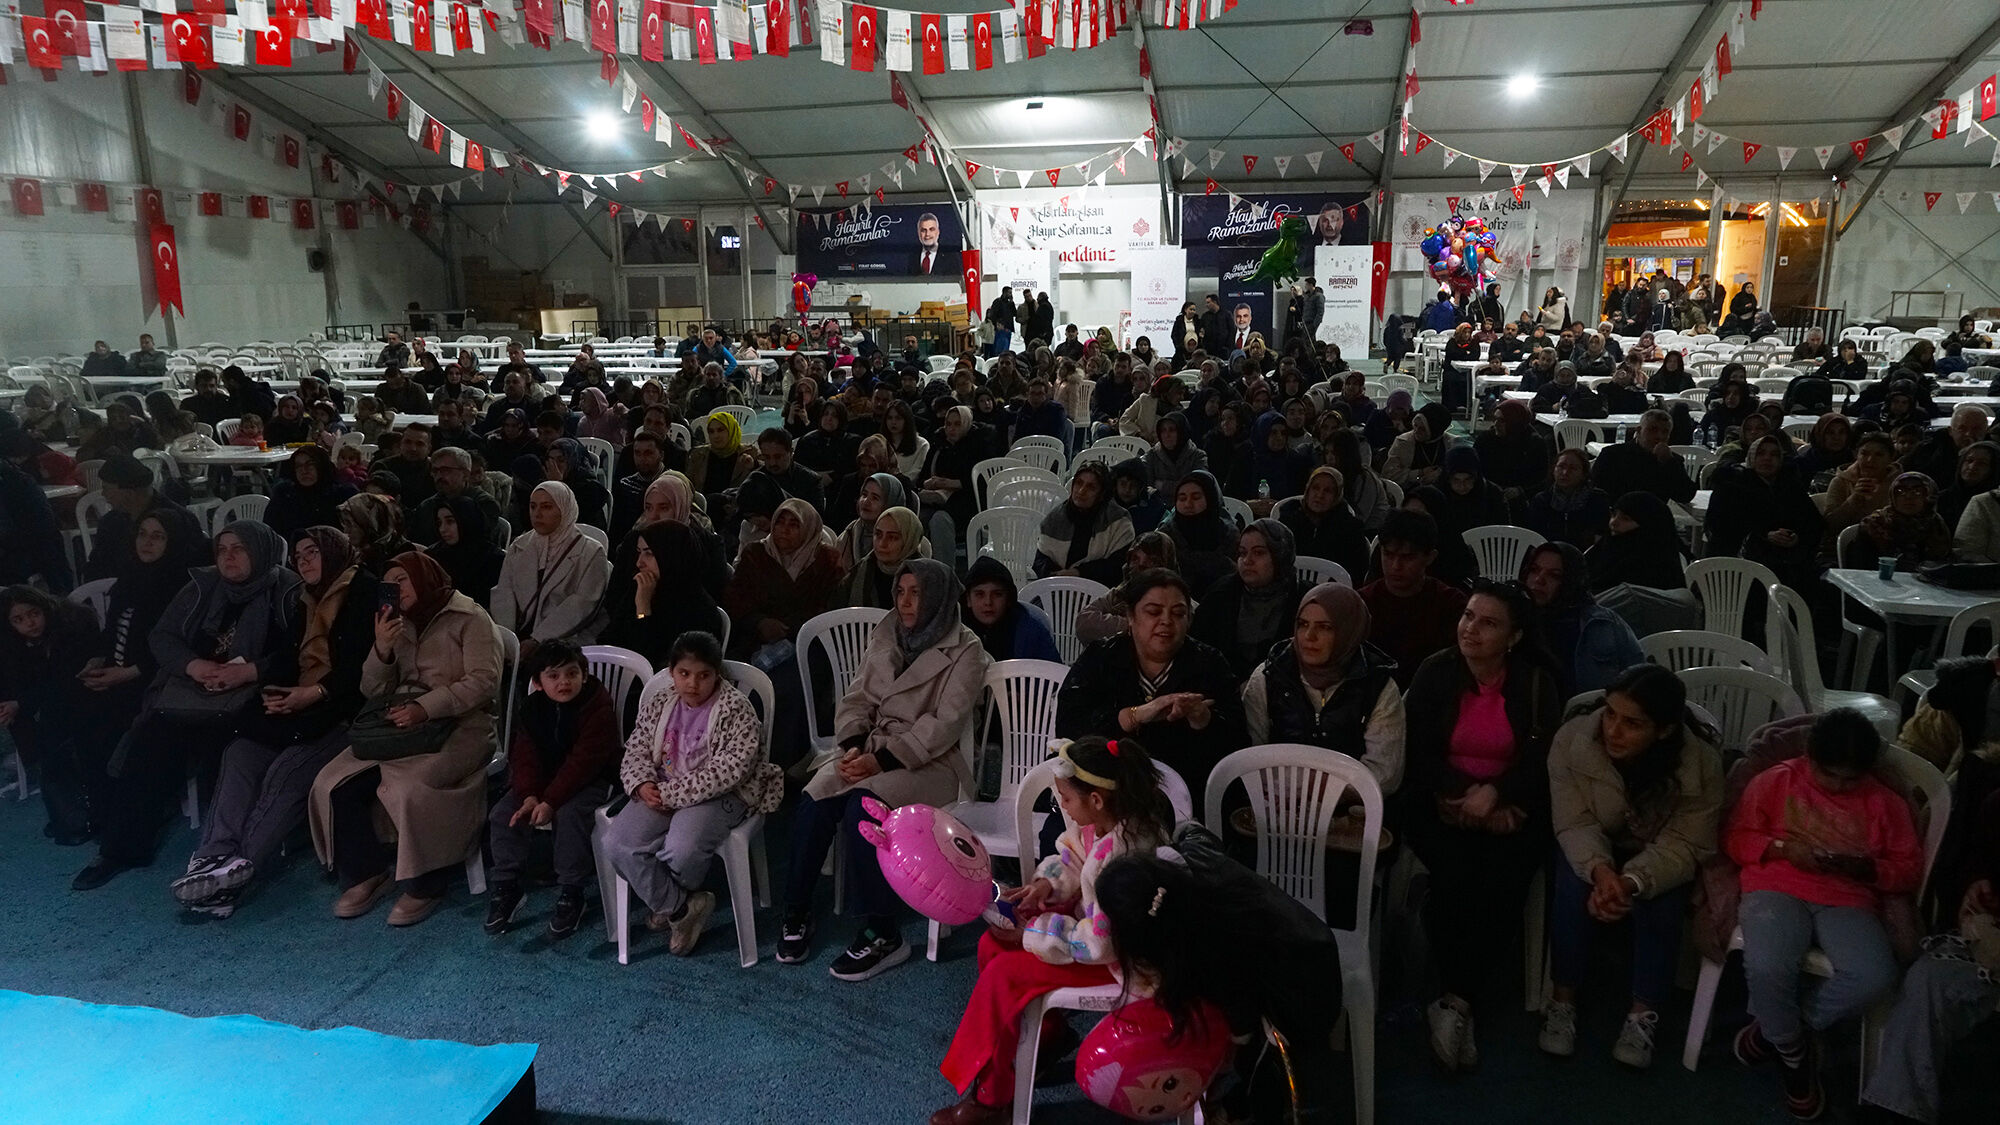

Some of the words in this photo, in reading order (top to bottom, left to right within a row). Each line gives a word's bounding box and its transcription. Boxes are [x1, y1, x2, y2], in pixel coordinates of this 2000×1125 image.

[819, 215, 902, 252] Ramazanlar
[834, 211, 873, 238] Hayırlı
[1026, 223, 1057, 241] Hayır
[1058, 222, 1112, 237] Soframıza
[1207, 204, 1302, 242] Ramazanla
